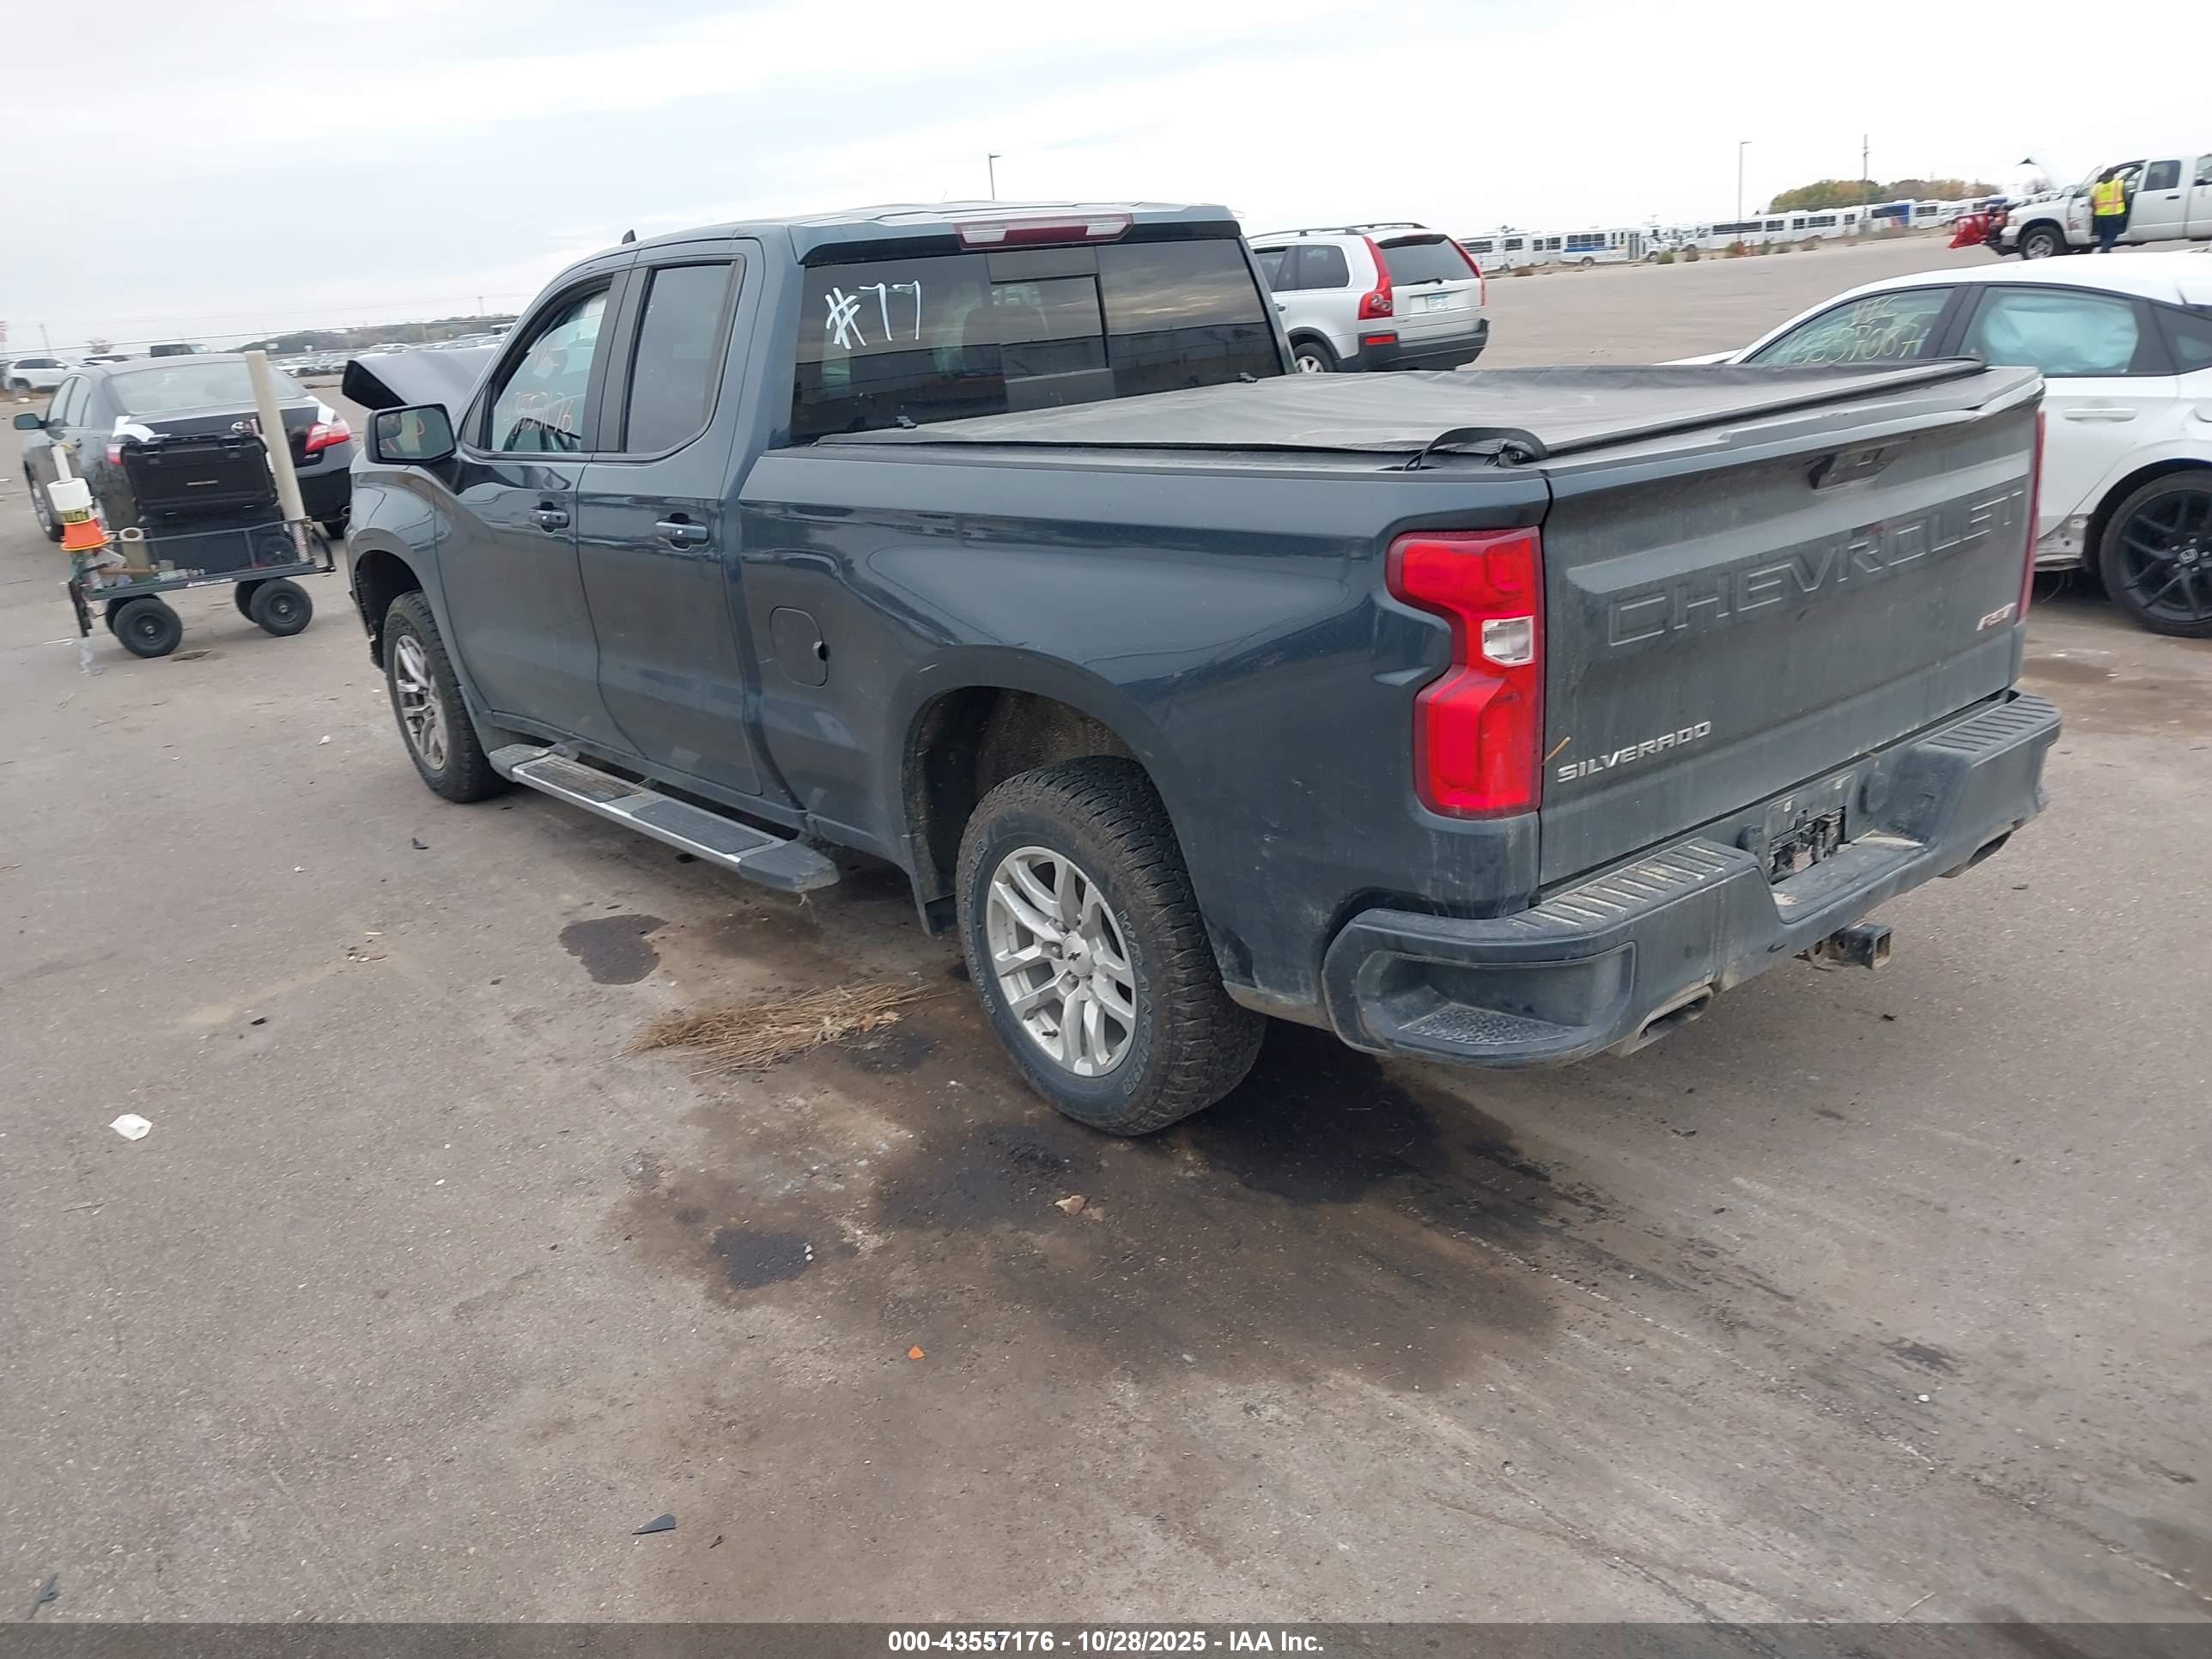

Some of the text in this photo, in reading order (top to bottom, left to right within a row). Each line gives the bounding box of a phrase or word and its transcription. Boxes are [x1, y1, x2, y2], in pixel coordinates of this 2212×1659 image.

[824, 280, 921, 350] #77
[1608, 490, 2024, 647] CHEVROLET
[1557, 720, 1711, 783] SILVERADO
